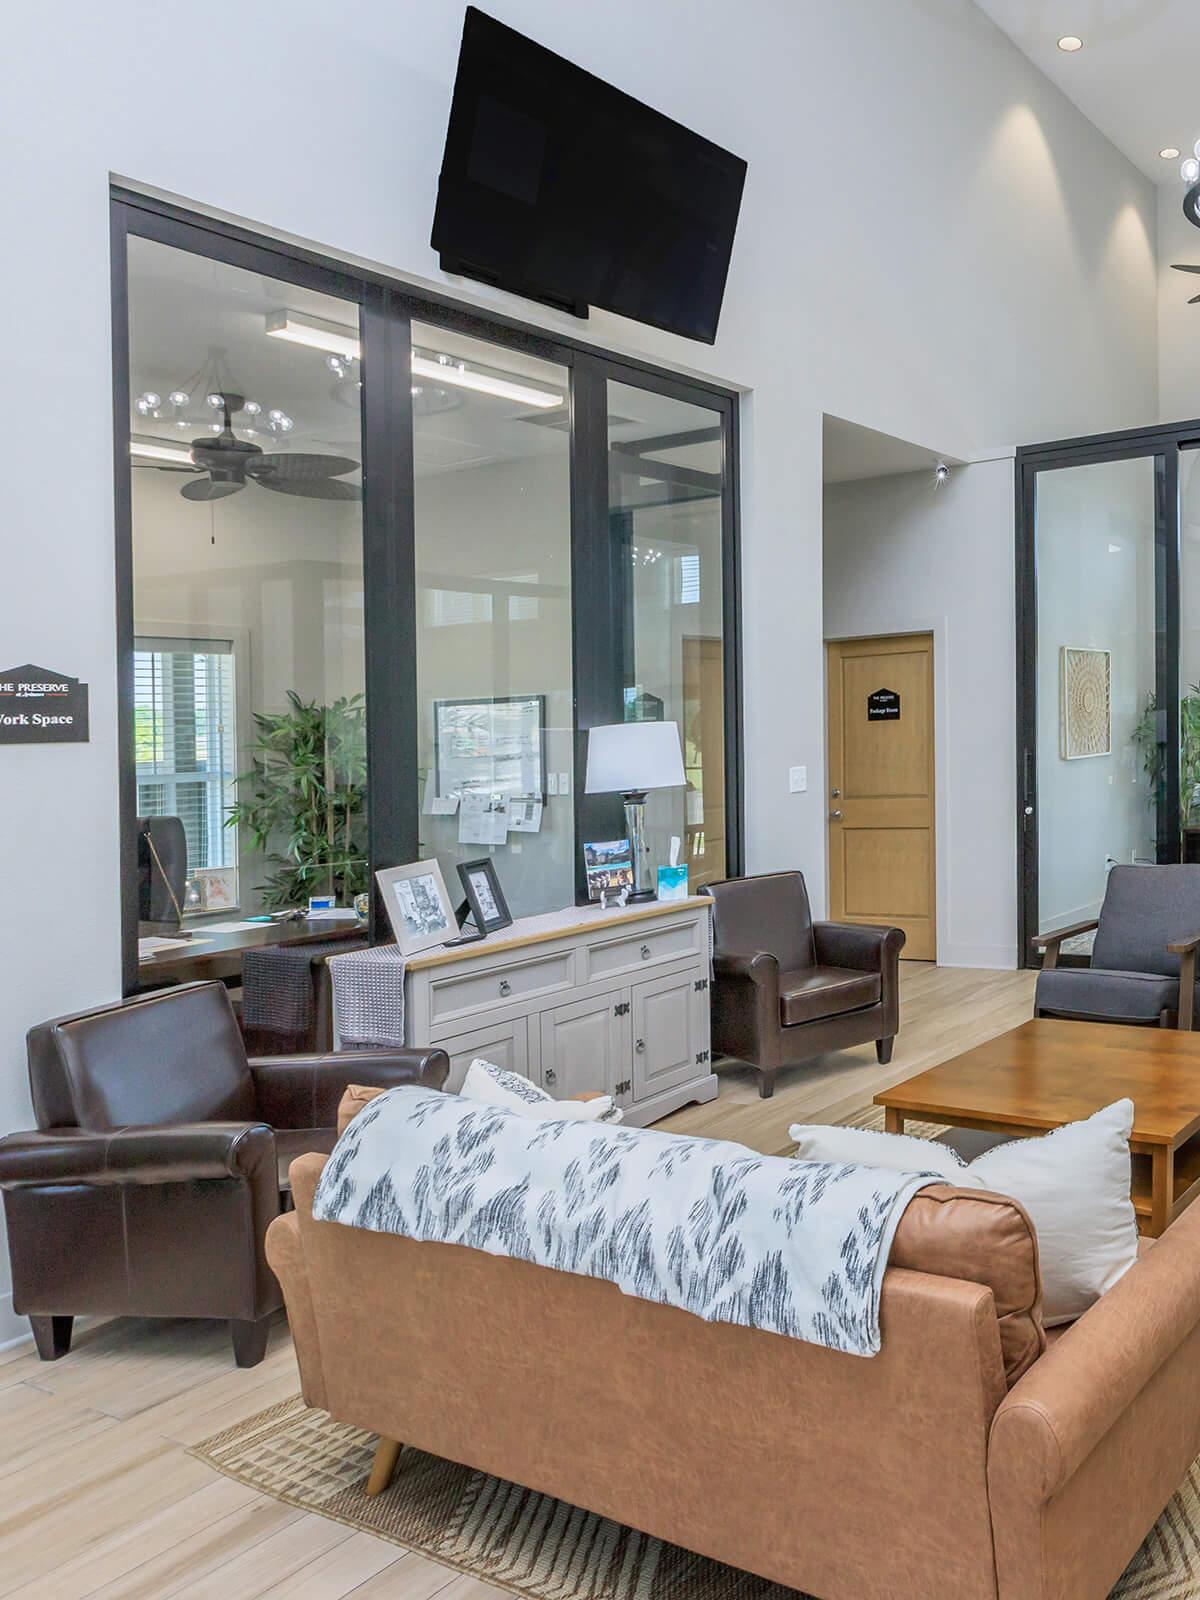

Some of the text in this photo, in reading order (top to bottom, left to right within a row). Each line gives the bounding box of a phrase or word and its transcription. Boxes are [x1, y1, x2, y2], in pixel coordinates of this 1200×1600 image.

[0, 683, 69, 692] HE PRESERVE
[32, 713, 73, 727] Space
